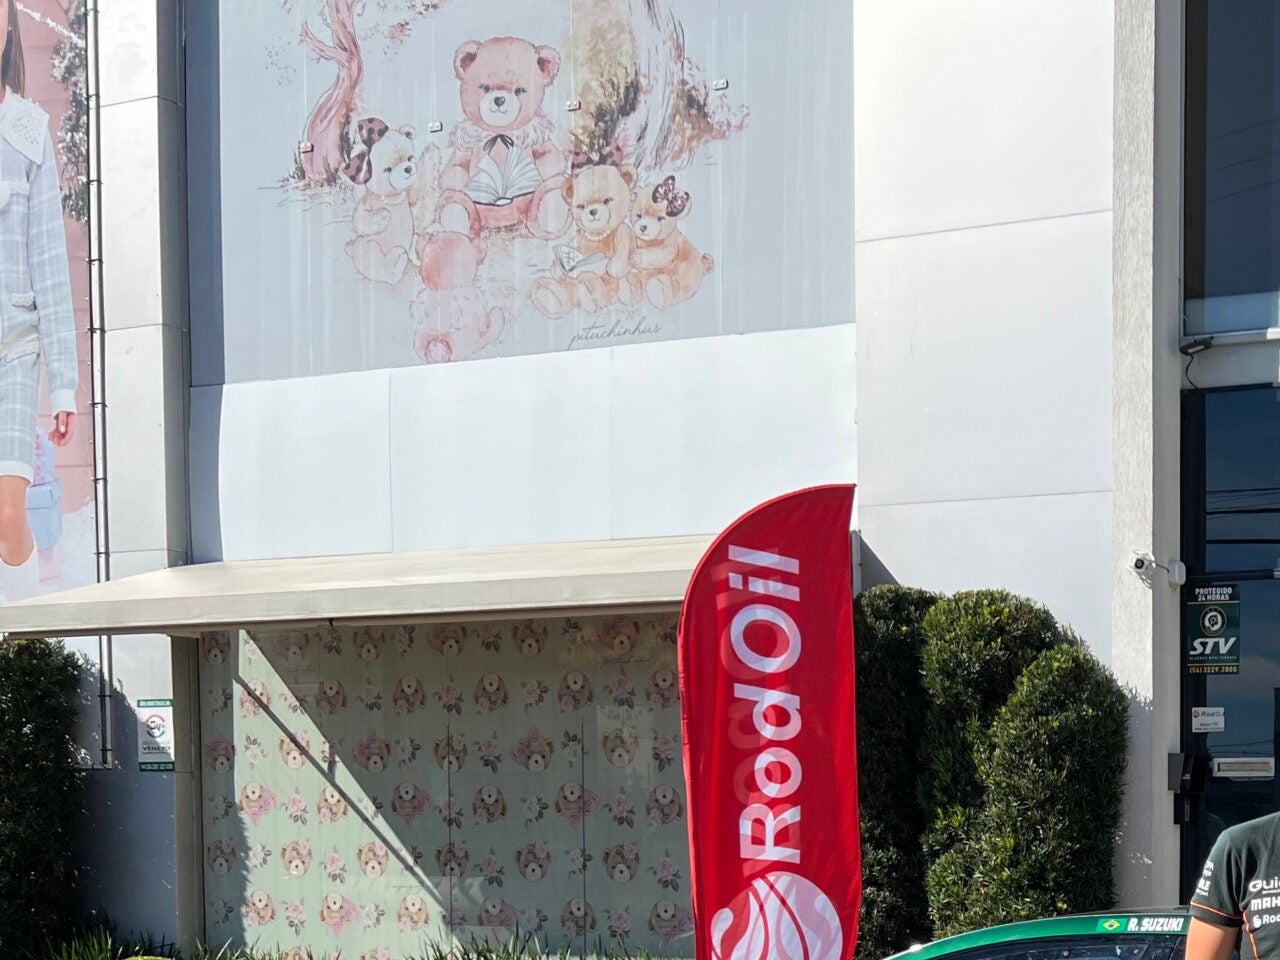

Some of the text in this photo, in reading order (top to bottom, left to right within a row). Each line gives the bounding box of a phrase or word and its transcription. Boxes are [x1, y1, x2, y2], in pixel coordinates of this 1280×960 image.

[1189, 637, 1237, 655] STV
[729, 544, 801, 864] RodOil
[1127, 917, 1184, 932] R. SUZUKI
